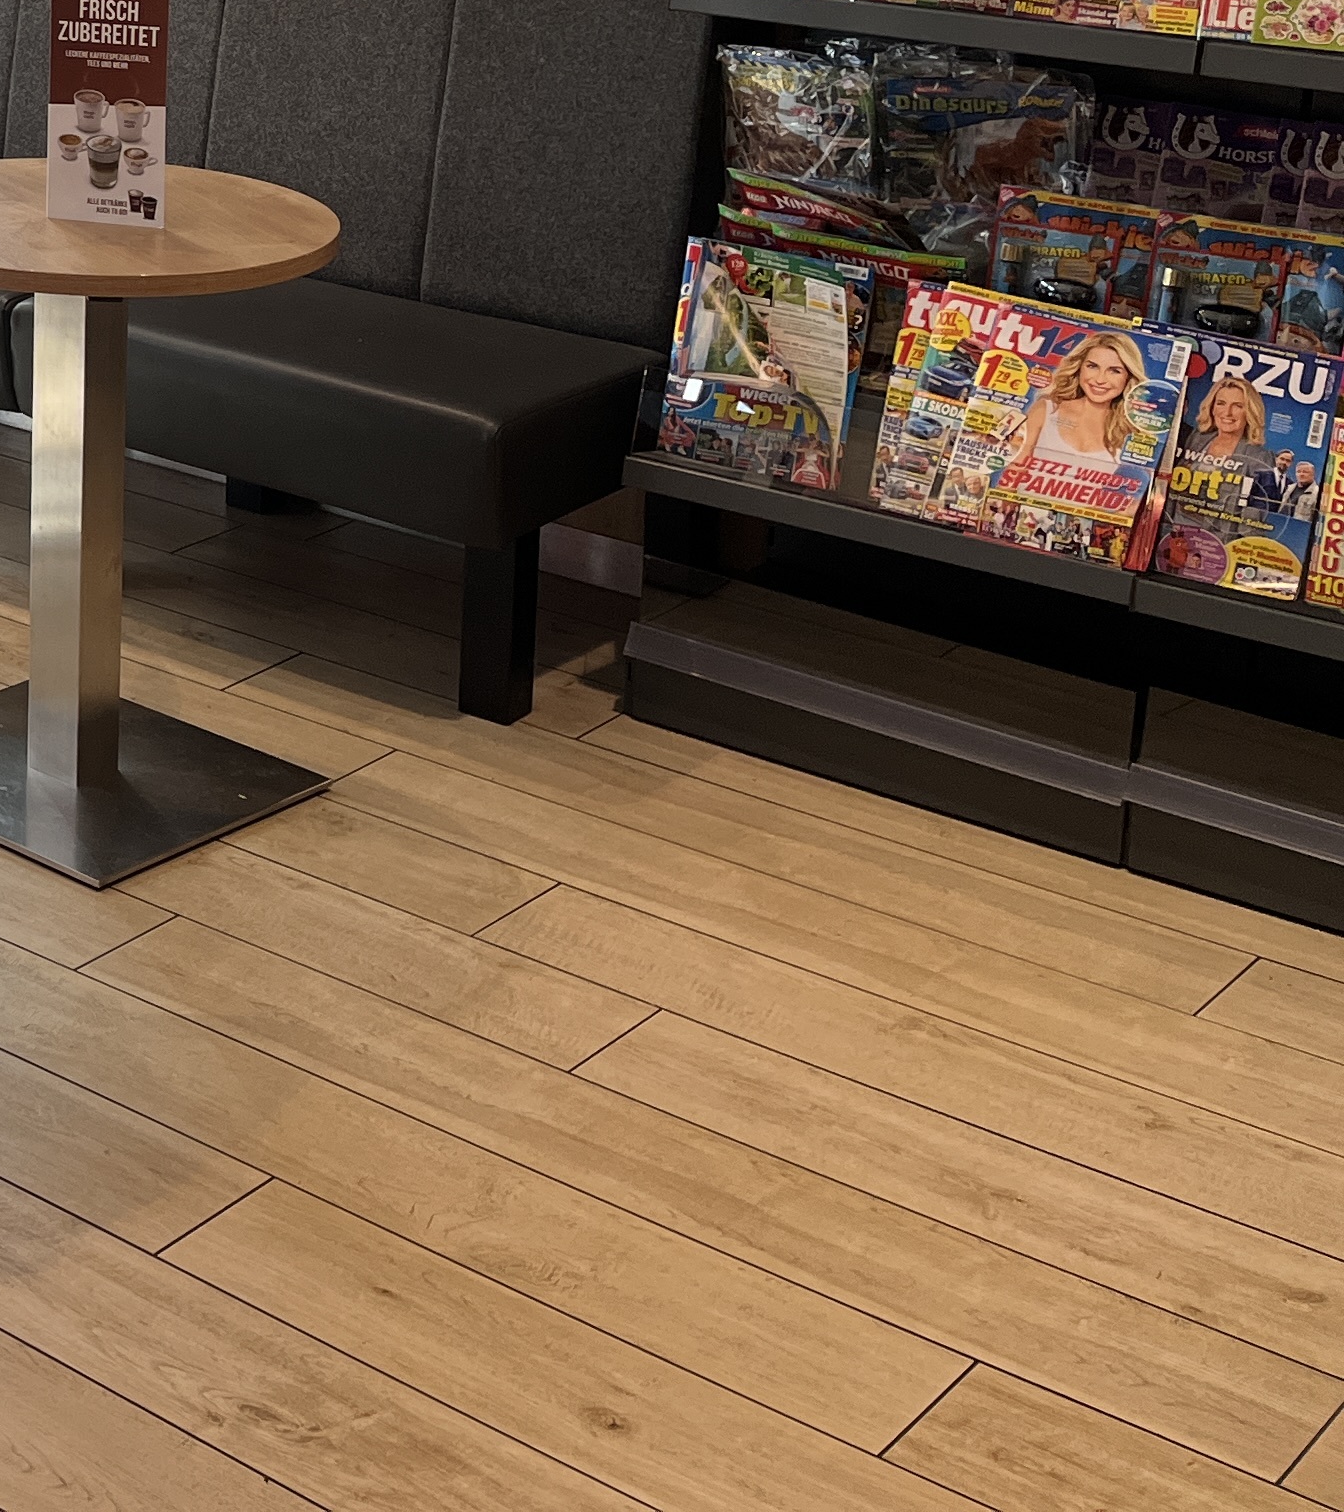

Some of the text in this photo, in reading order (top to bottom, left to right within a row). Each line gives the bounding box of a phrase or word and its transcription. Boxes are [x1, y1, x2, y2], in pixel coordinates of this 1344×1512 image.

[58, 20, 161, 47] ZUBEREITET
[895, 95, 1009, 114] Dinosaurs
[957, 445, 987, 459] TRICKS
[1184, 448, 1244, 471] wieder
[1015, 456, 1073, 477] JETZT
[998, 468, 1135, 512] SPANNEND!
